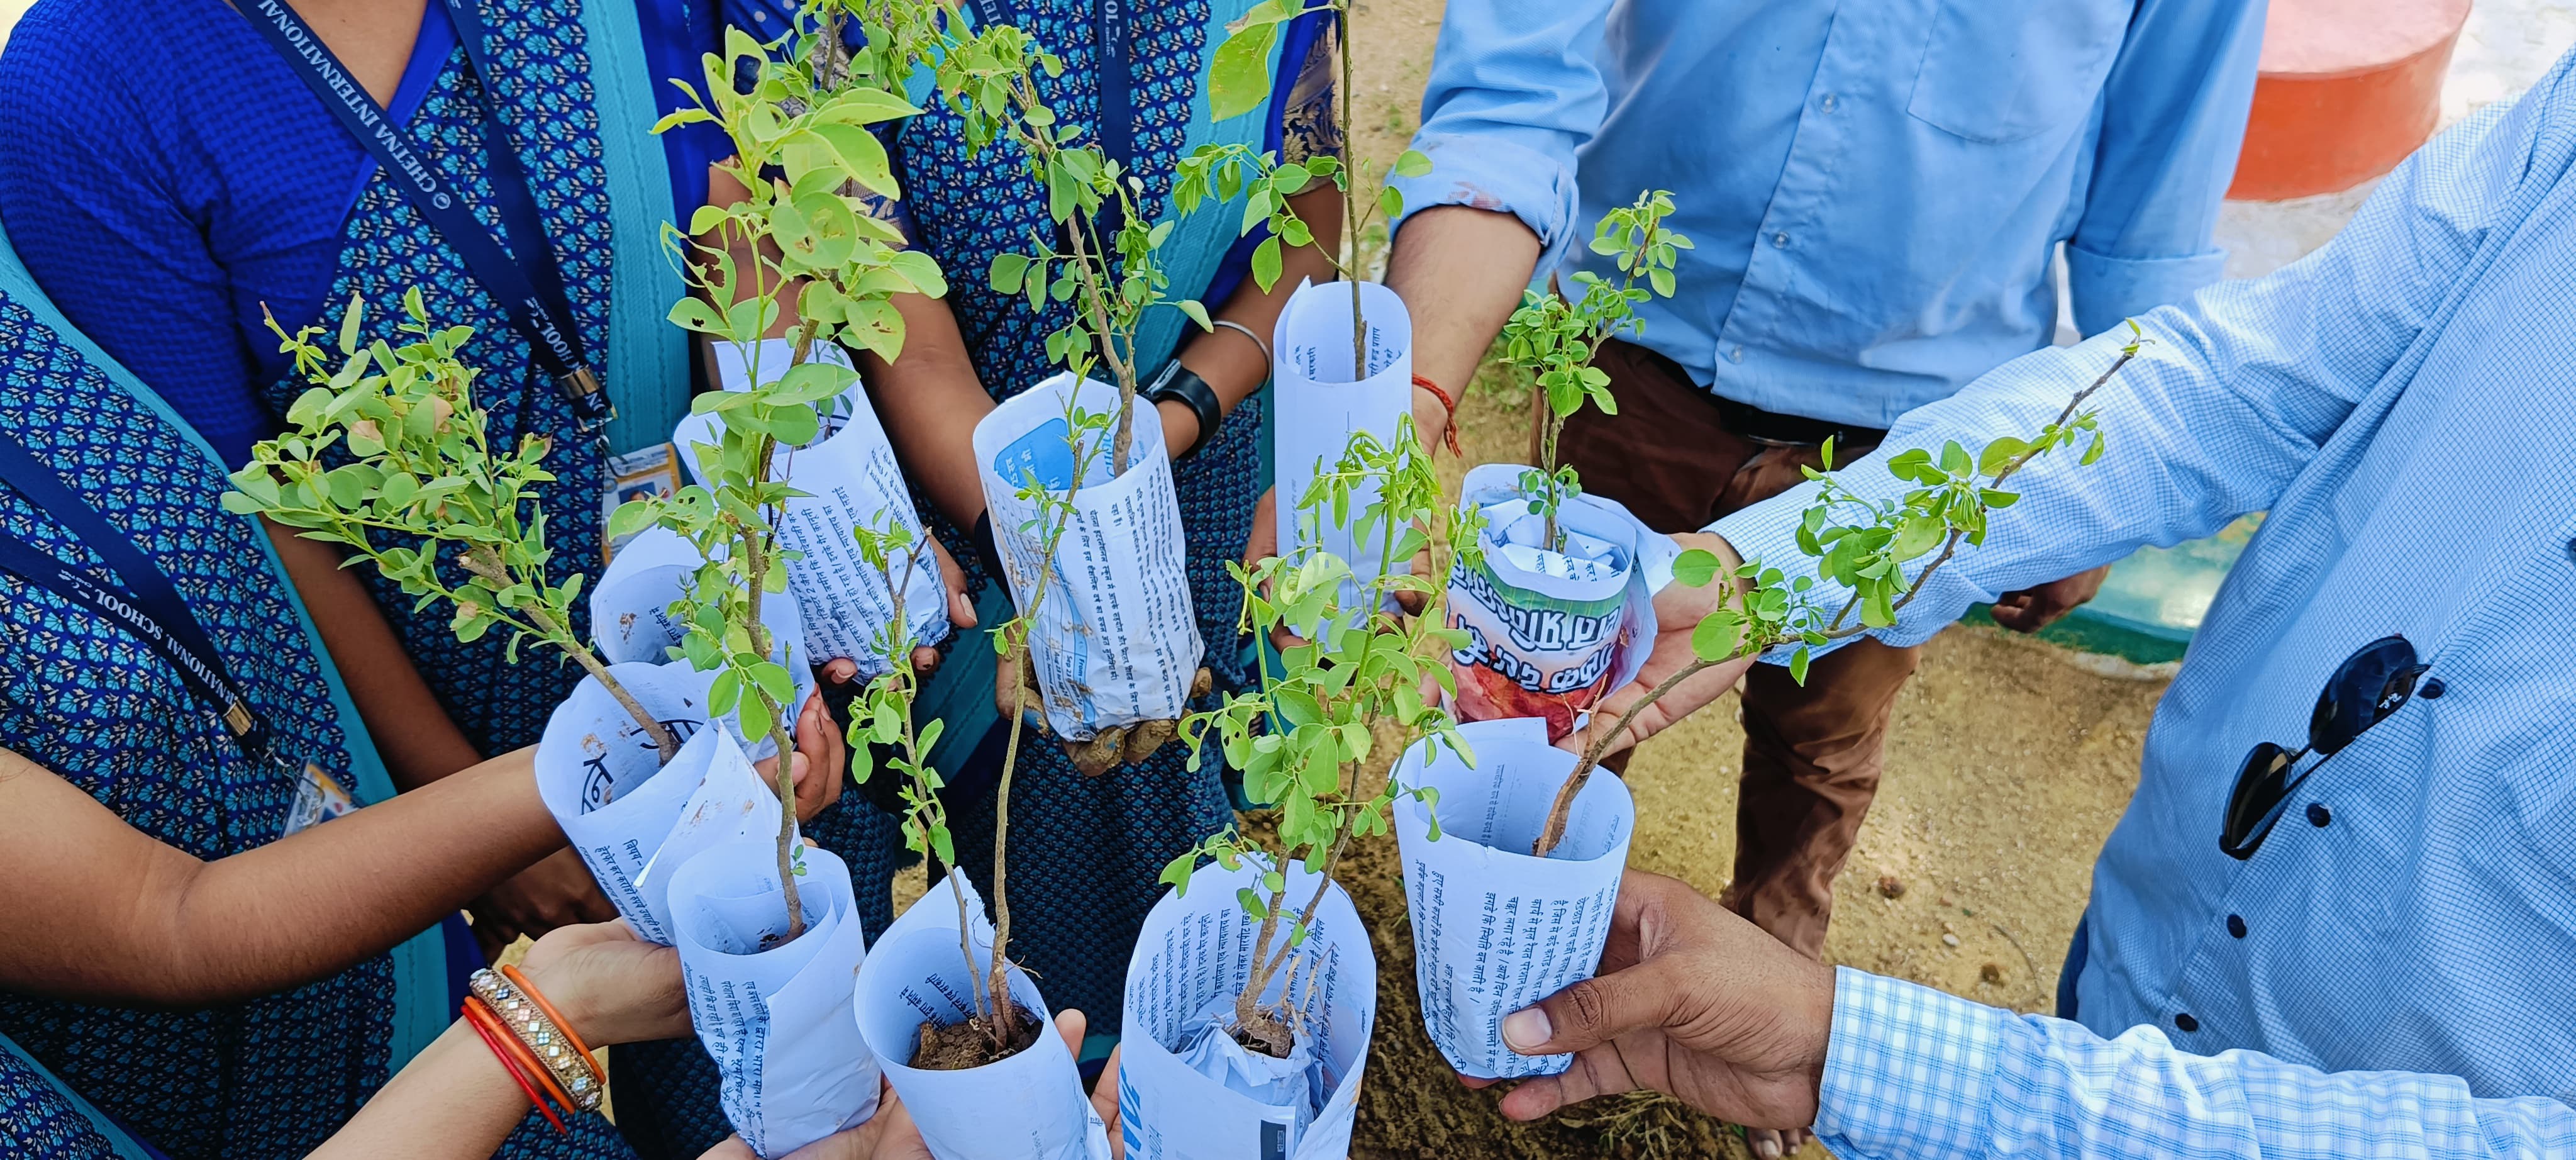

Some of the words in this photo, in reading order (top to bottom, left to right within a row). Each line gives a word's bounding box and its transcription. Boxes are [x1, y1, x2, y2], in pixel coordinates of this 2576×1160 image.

[258, 0, 380, 127] INTERNATIONAL
[375, 124, 436, 192] CHETNA
[823, 506, 833, 516] का
[828, 516, 849, 548] न्यायालय
[816, 572, 831, 592] जमीन
[853, 560, 871, 588] कार्यालय
[649, 606, 659, 615] में
[826, 593, 843, 613] निजी
[95, 589, 162, 640] SCHOOL
[655, 613, 670, 629] जमीन
[595, 845, 616, 865] हेरफेर
[610, 866, 623, 875] कर
[639, 909, 660, 926] उगाही
[1432, 871, 1443, 886] हुए
[1433, 888, 1444, 906] सभी
[1530, 899, 1543, 915] कार्य
[1482, 914, 1496, 925] कि
[1551, 908, 1567, 924] जिस
[1218, 920, 1230, 950] न्यायालय
[1504, 918, 1514, 935] लगा
[1523, 927, 1536, 940] मूल
[1478, 927, 1494, 951] स्थिति
[1497, 937, 1515, 948] रहे
[1522, 942, 1538, 959] रैयत
[1234, 954, 1248, 969] लेकर
[1213, 963, 1225, 991] कार्यालय
[1473, 965, 1486, 984] जाती
[1496, 964, 1509, 980] आये
[1518, 961, 1533, 984] परेशान
[1573, 973, 1587, 982] ही
[925, 973, 949, 993] सरकारी
[1493, 981, 1507, 997] दिन
[757, 1016, 770, 1024] के
[1165, 1006, 1173, 1017] 2
[733, 1028, 748, 1036] है
[755, 1027, 765, 1052] द्वारा
[713, 1042, 728, 1054] ही
